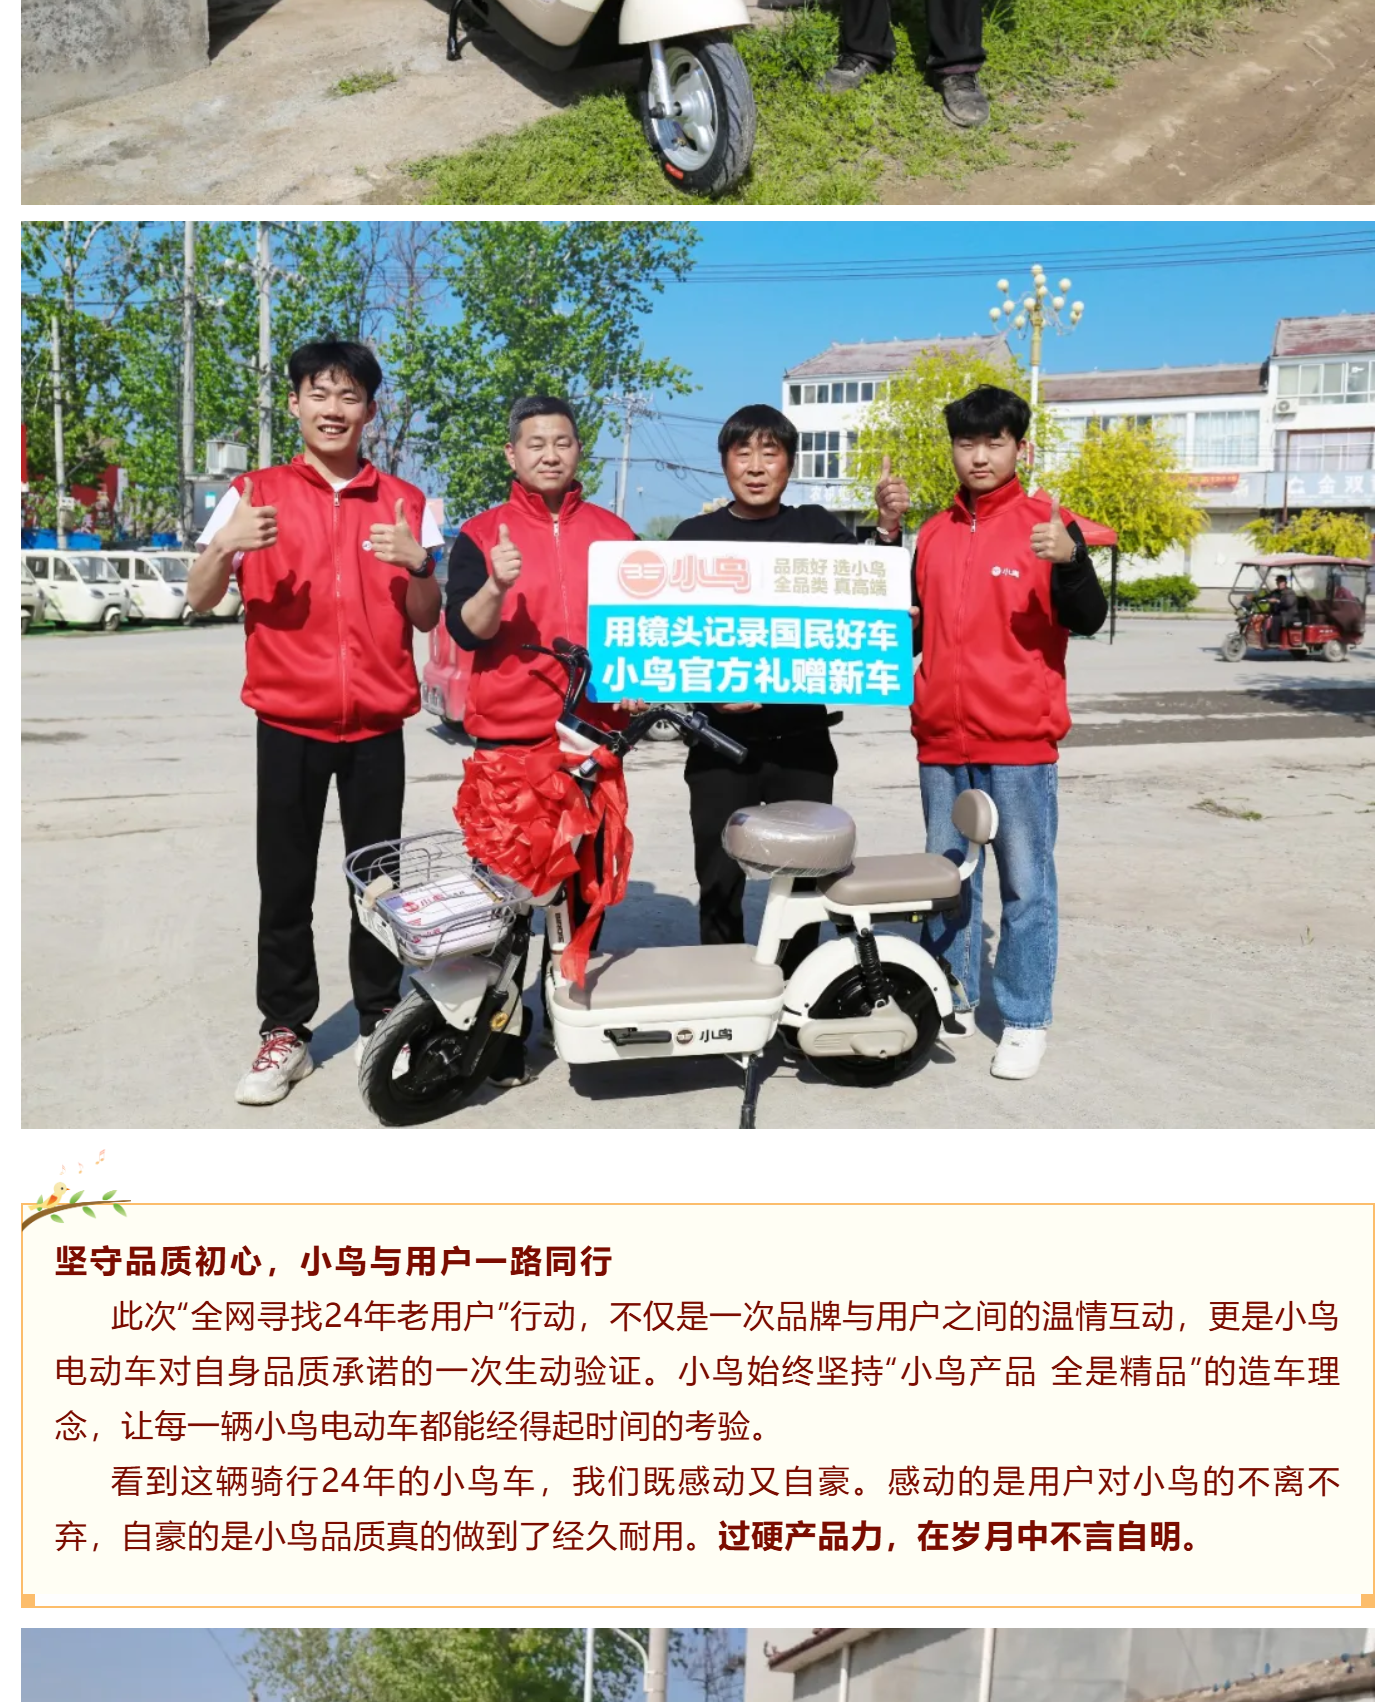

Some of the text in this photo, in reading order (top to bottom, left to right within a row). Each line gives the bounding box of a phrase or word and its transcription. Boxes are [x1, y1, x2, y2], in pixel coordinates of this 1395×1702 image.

[669, 554, 751, 593] 小鸟
[773, 557, 887, 578] 品质好 选小鸟
[773, 576, 888, 597] 全品类 真高端
[603, 615, 899, 652] 用镜头记录国民好车
[601, 655, 901, 697] 小鸟官方礼赠新车
